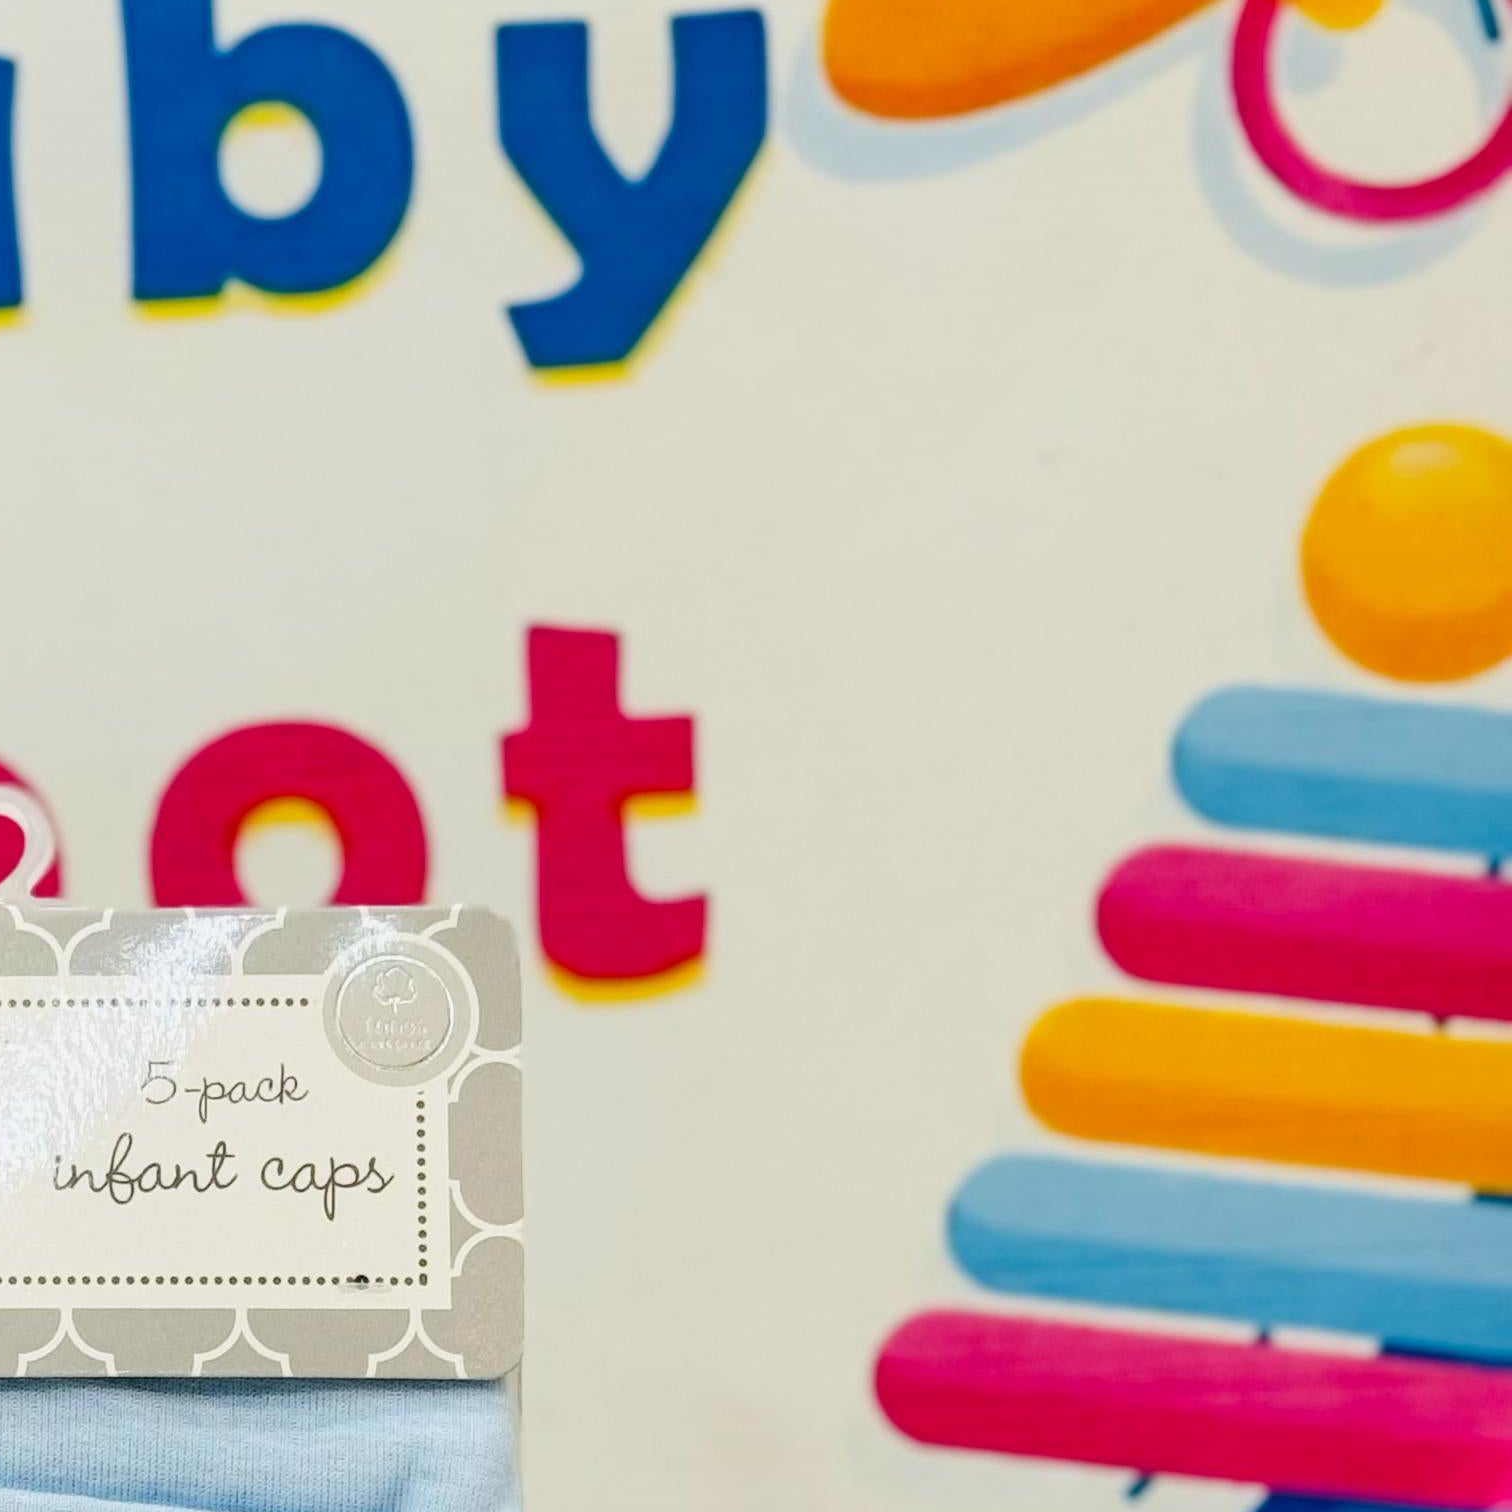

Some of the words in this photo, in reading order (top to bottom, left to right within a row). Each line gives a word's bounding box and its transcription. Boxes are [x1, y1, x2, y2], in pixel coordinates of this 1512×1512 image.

[141, 1060, 309, 1124] 5-pack
[52, 1132, 238, 1204] infant
[260, 1156, 394, 1221] caps
